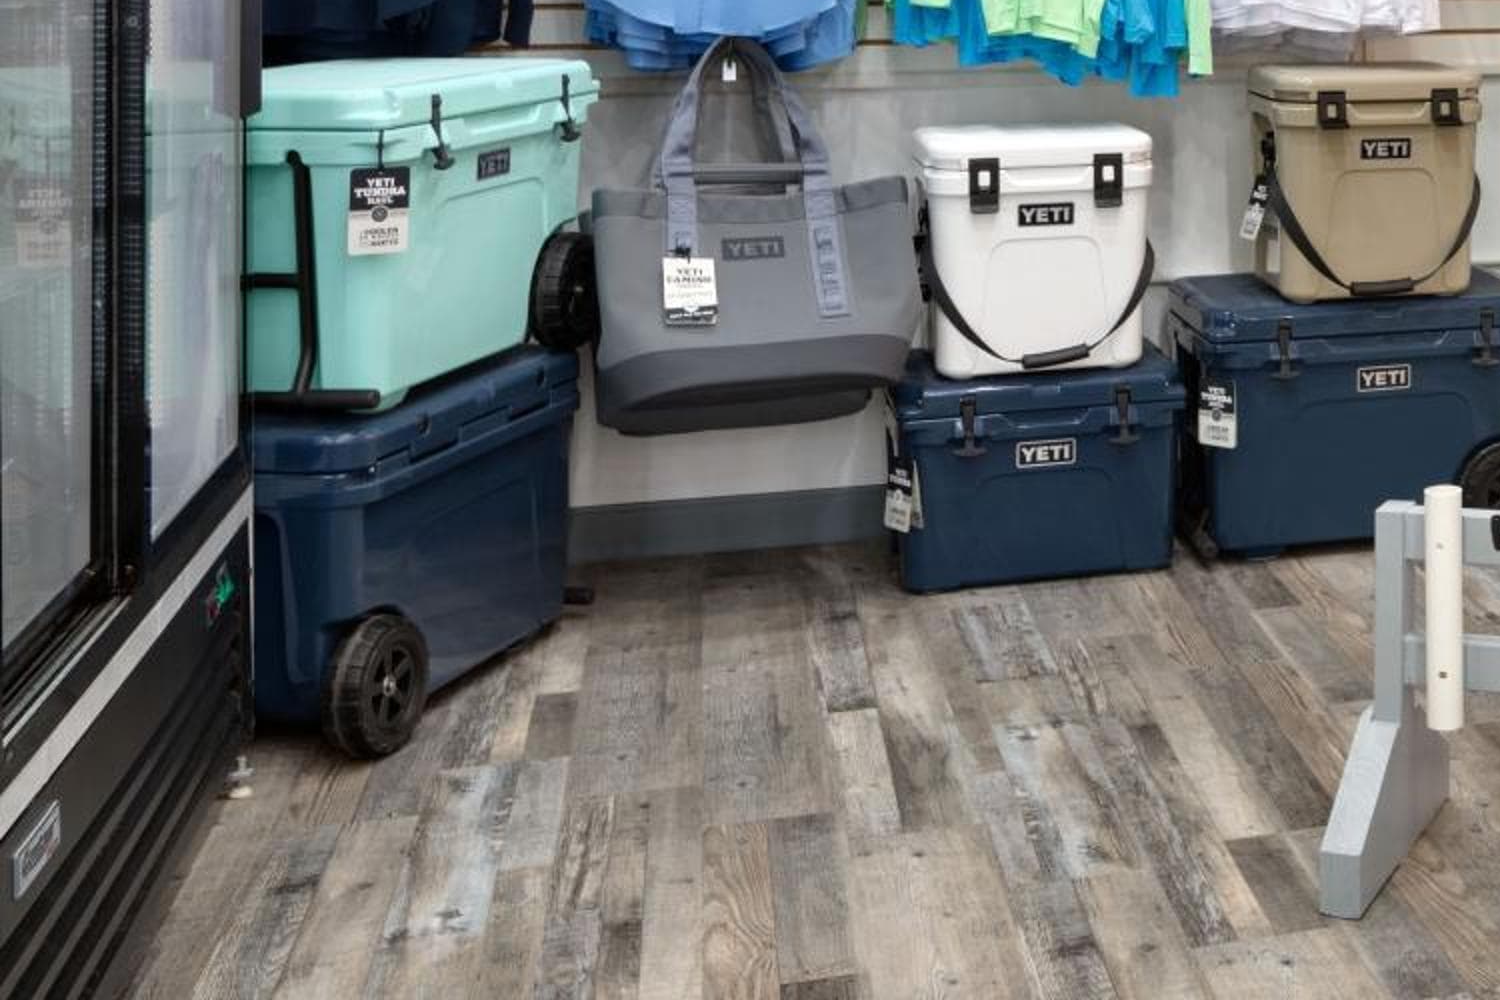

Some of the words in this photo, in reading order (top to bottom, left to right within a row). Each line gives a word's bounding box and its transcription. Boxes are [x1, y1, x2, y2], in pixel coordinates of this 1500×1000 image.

[1364, 142, 1409, 157] YETI
[480, 152, 509, 175] YETI
[368, 178, 395, 188] YETI
[354, 186, 406, 198] TUNDRA
[1022, 206, 1070, 223] YETI
[728, 242, 781, 257] YETI
[667, 275, 712, 284] CAMINO
[676, 268, 703, 276] YETI
[1361, 370, 1407, 386] YETI
[1022, 444, 1071, 462] YETI
